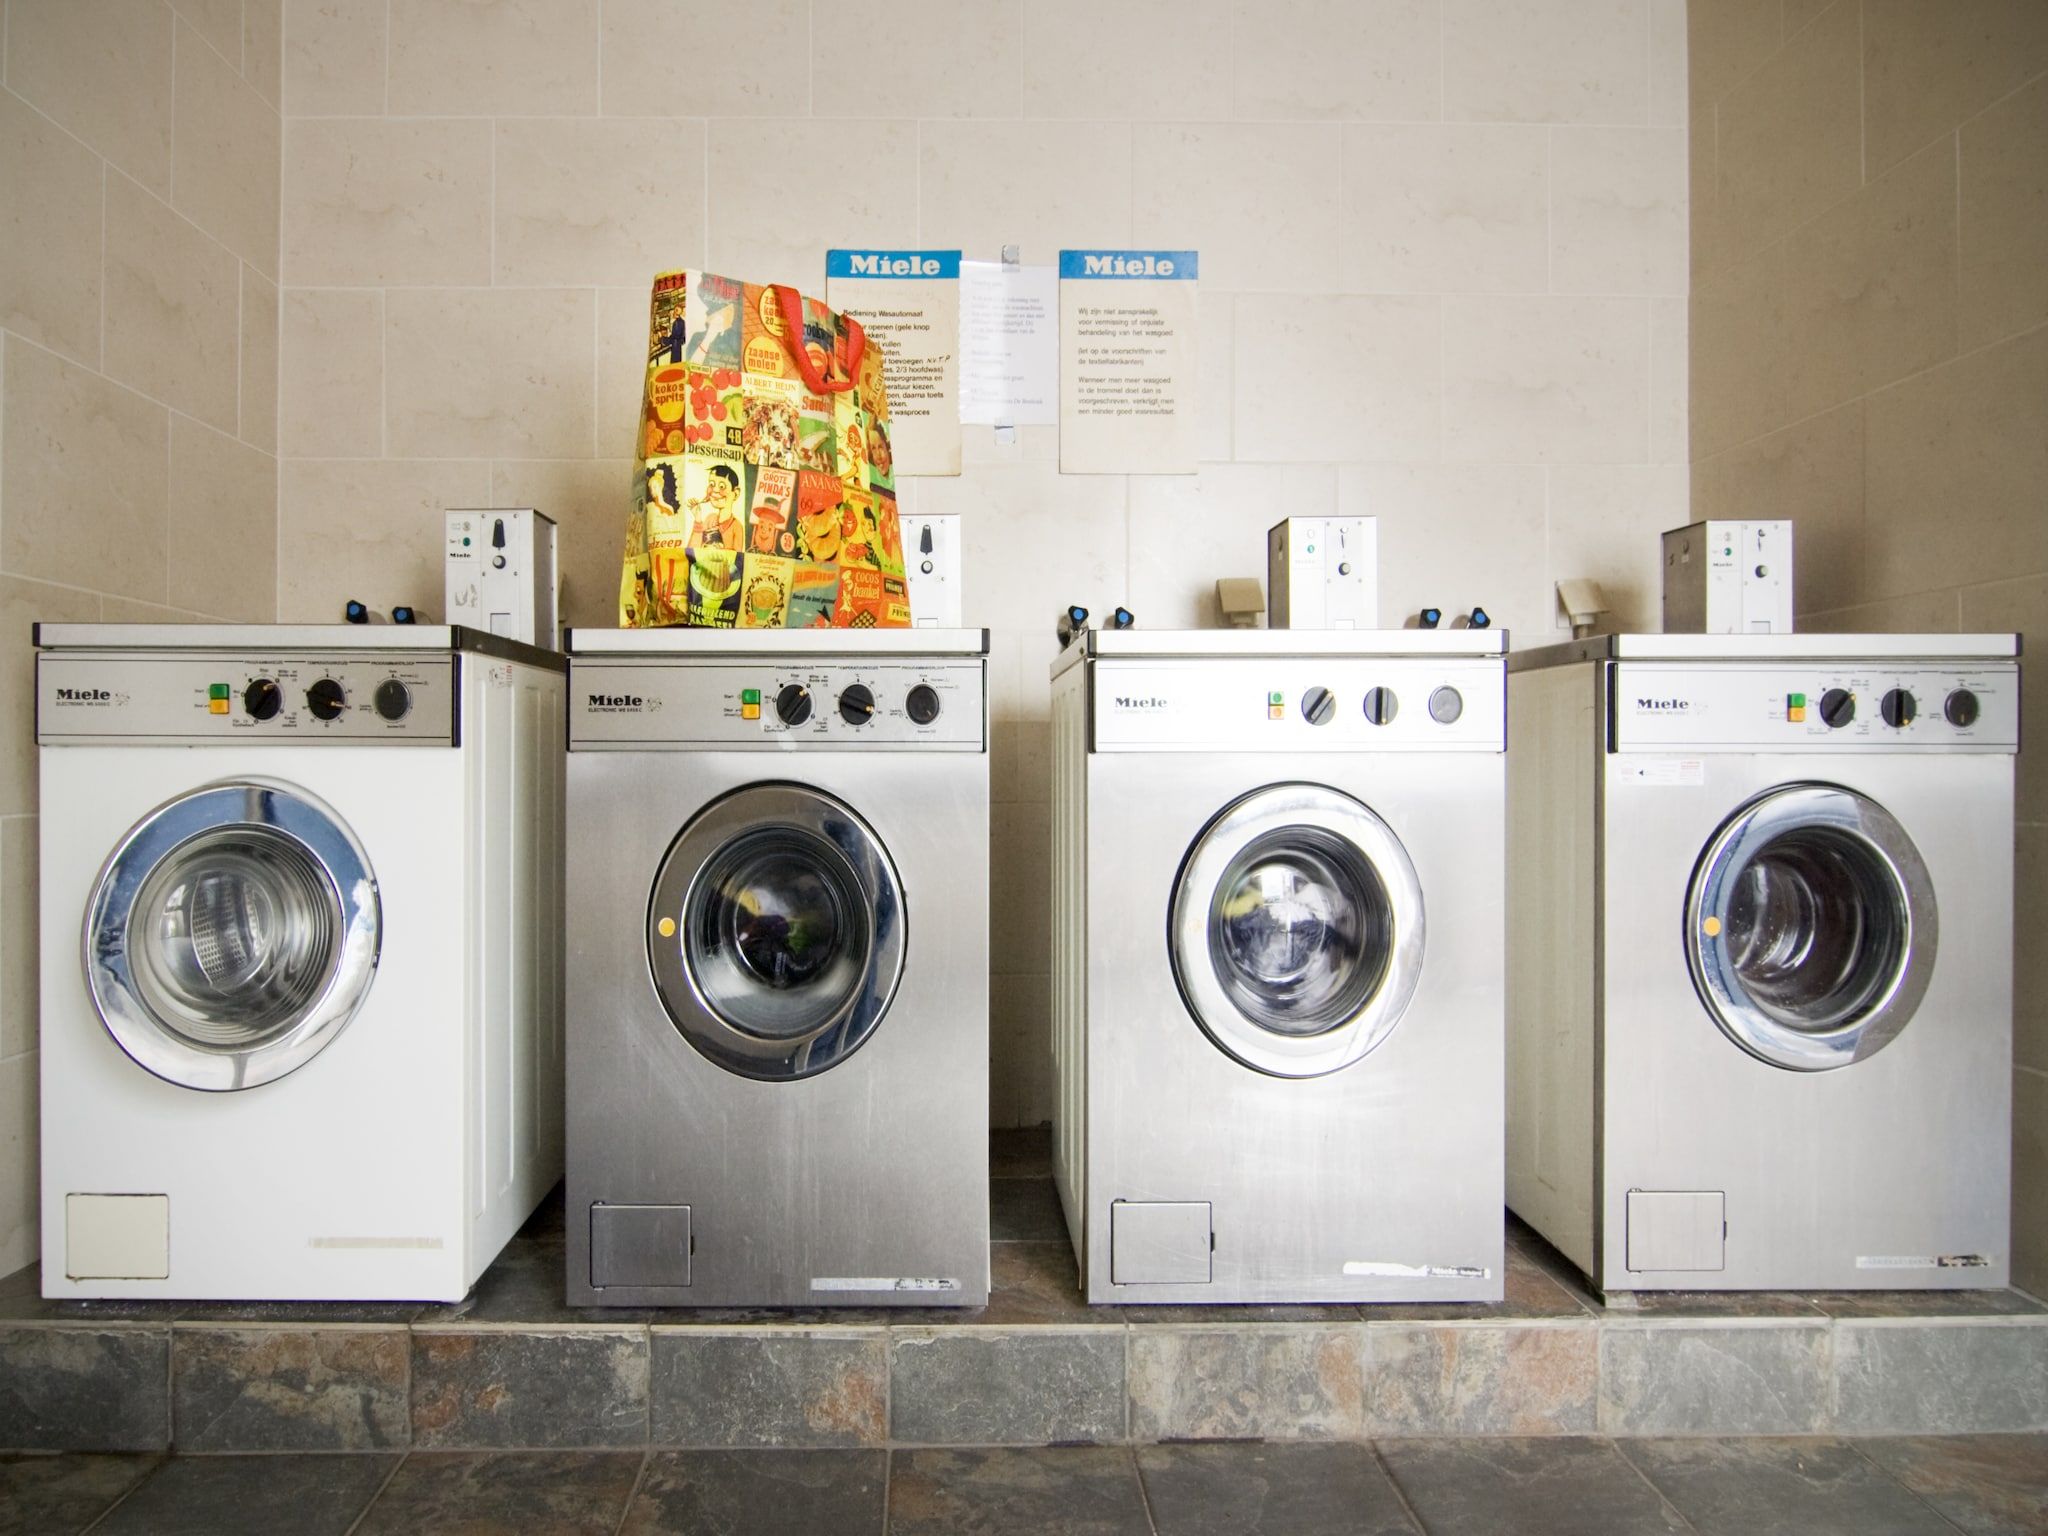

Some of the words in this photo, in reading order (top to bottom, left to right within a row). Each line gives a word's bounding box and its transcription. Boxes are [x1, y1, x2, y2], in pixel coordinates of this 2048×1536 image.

[850, 255, 940, 275] Miele
[1084, 255, 1174, 275] Miele
[1090, 308, 1101, 316] zijn
[913, 324, 930, 332] knop
[1095, 319, 1129, 327] vermissing
[1078, 329, 1117, 338] behandeling
[748, 347, 780, 361] zaanse
[1111, 347, 1153, 355] voorschriften
[748, 359, 777, 371] molen
[888, 357, 924, 365] toevoegen
[1078, 376, 1106, 384] Wanneer
[1143, 377, 1172, 386] wasgoed
[655, 383, 685, 394] kokos
[902, 390, 925, 398] daarna
[655, 391, 685, 406] sprits
[894, 409, 931, 417] wasproces
[1116, 408, 1133, 417] goed
[688, 442, 742, 462] bessensap
[762, 472, 788, 485] GROTE
[801, 474, 842, 494] ANANAS
[758, 481, 791, 498] PINDA'S
[56, 688, 111, 700] Miele
[588, 694, 643, 706] Miele
[1115, 697, 1168, 708] Miele
[1637, 698, 1690, 709] Miele
